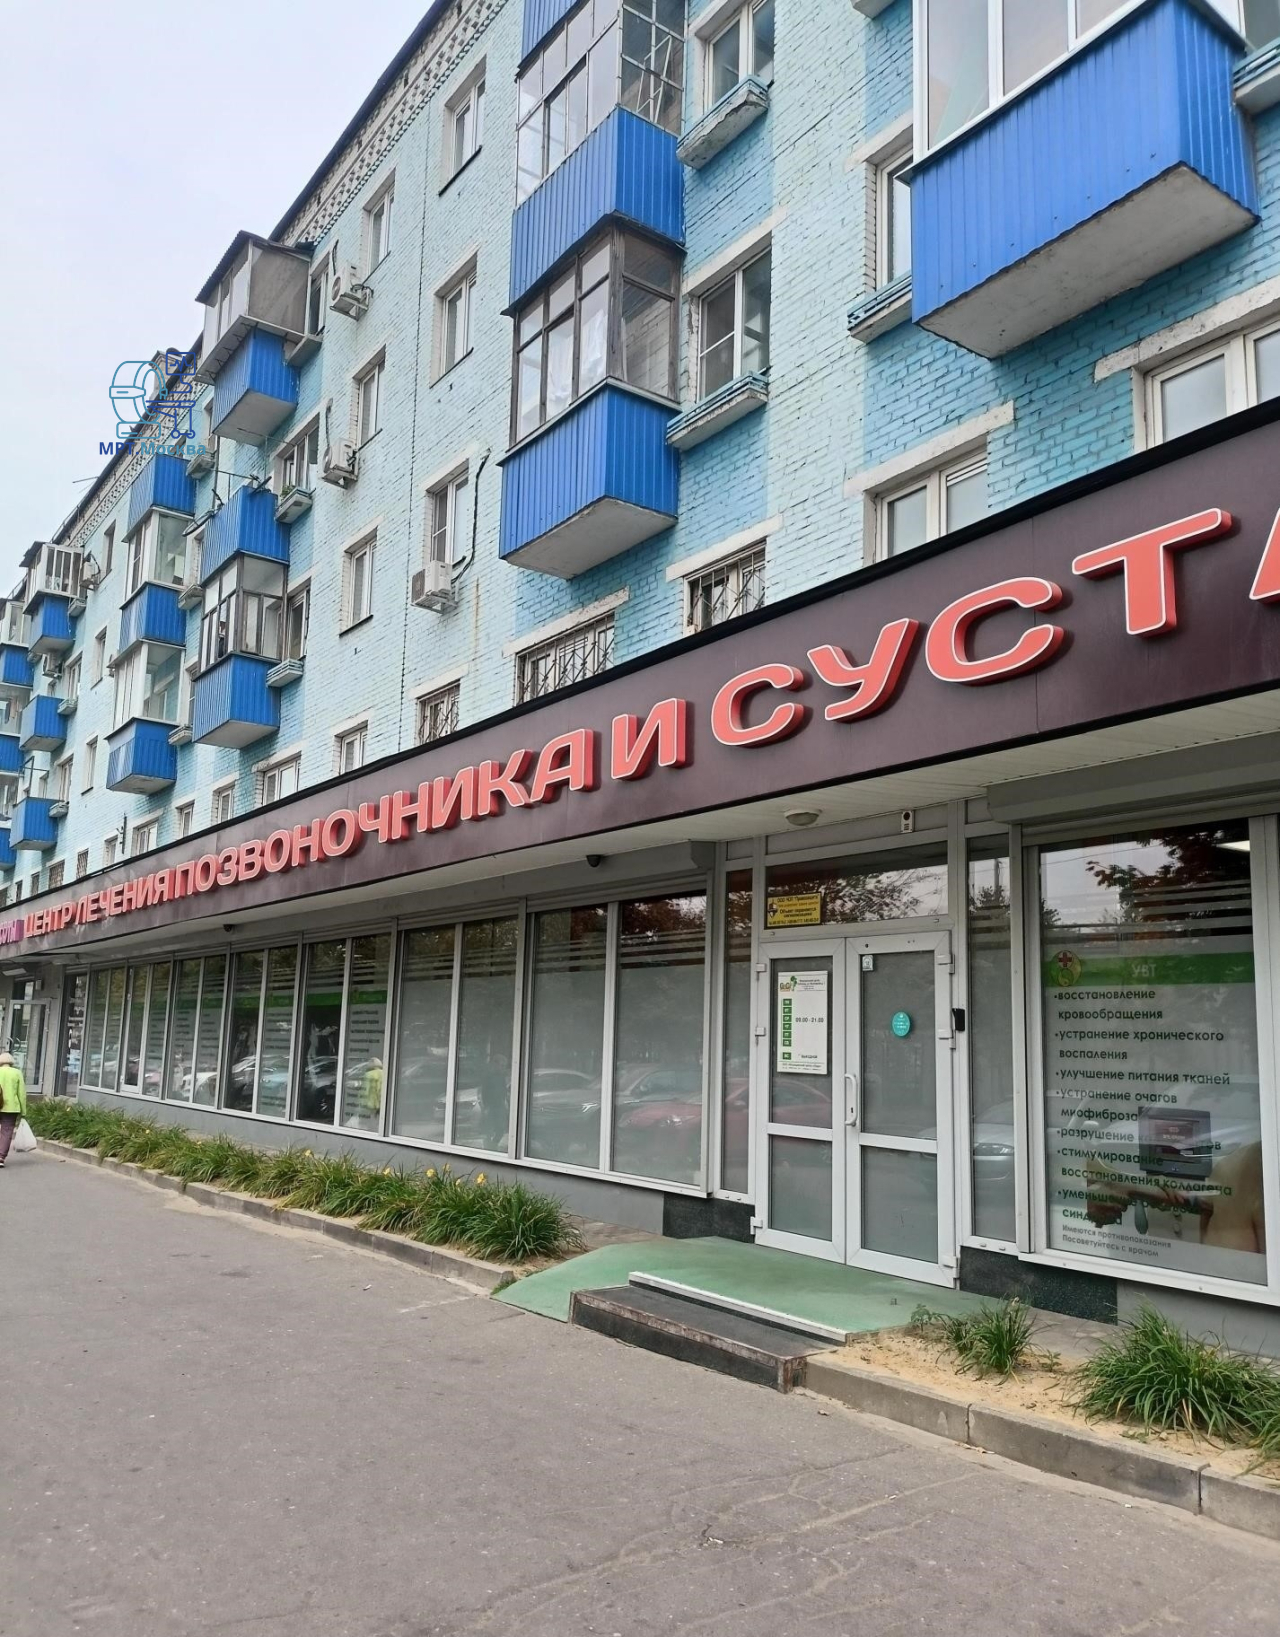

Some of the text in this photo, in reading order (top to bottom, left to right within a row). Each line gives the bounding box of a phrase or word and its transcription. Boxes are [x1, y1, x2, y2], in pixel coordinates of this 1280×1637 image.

[24, 901, 76, 938] ЦЕНТР
[75, 868, 174, 925] ЛЕЧЕНИЯ
[174, 728, 594, 898] ПОЗВОНОЧНИКА
[611, 698, 687, 780] И
[1058, 989, 1155, 1000] восстановление
[1058, 1009, 1163, 1021] кровообращения
[1059, 1030, 1224, 1042] устранение хронического
[1059, 1049, 1127, 1060] воспаления
[1060, 1068, 1230, 1085] улучшение питания тканей
[1061, 1087, 1177, 1103] устранение очагов
[1061, 1107, 1138, 1123] миофиброза
[1061, 1128, 1134, 1142] разрушение
[1061, 1147, 1163, 1166] стимулирование
[1062, 1167, 1232, 1195] восстановления коллагена
[1062, 1225, 1171, 1248] Имеются противопоказания
[1062, 1235, 1119, 1251] Посоветуйтесь
[1129, 1246, 1159, 1257] врачом
